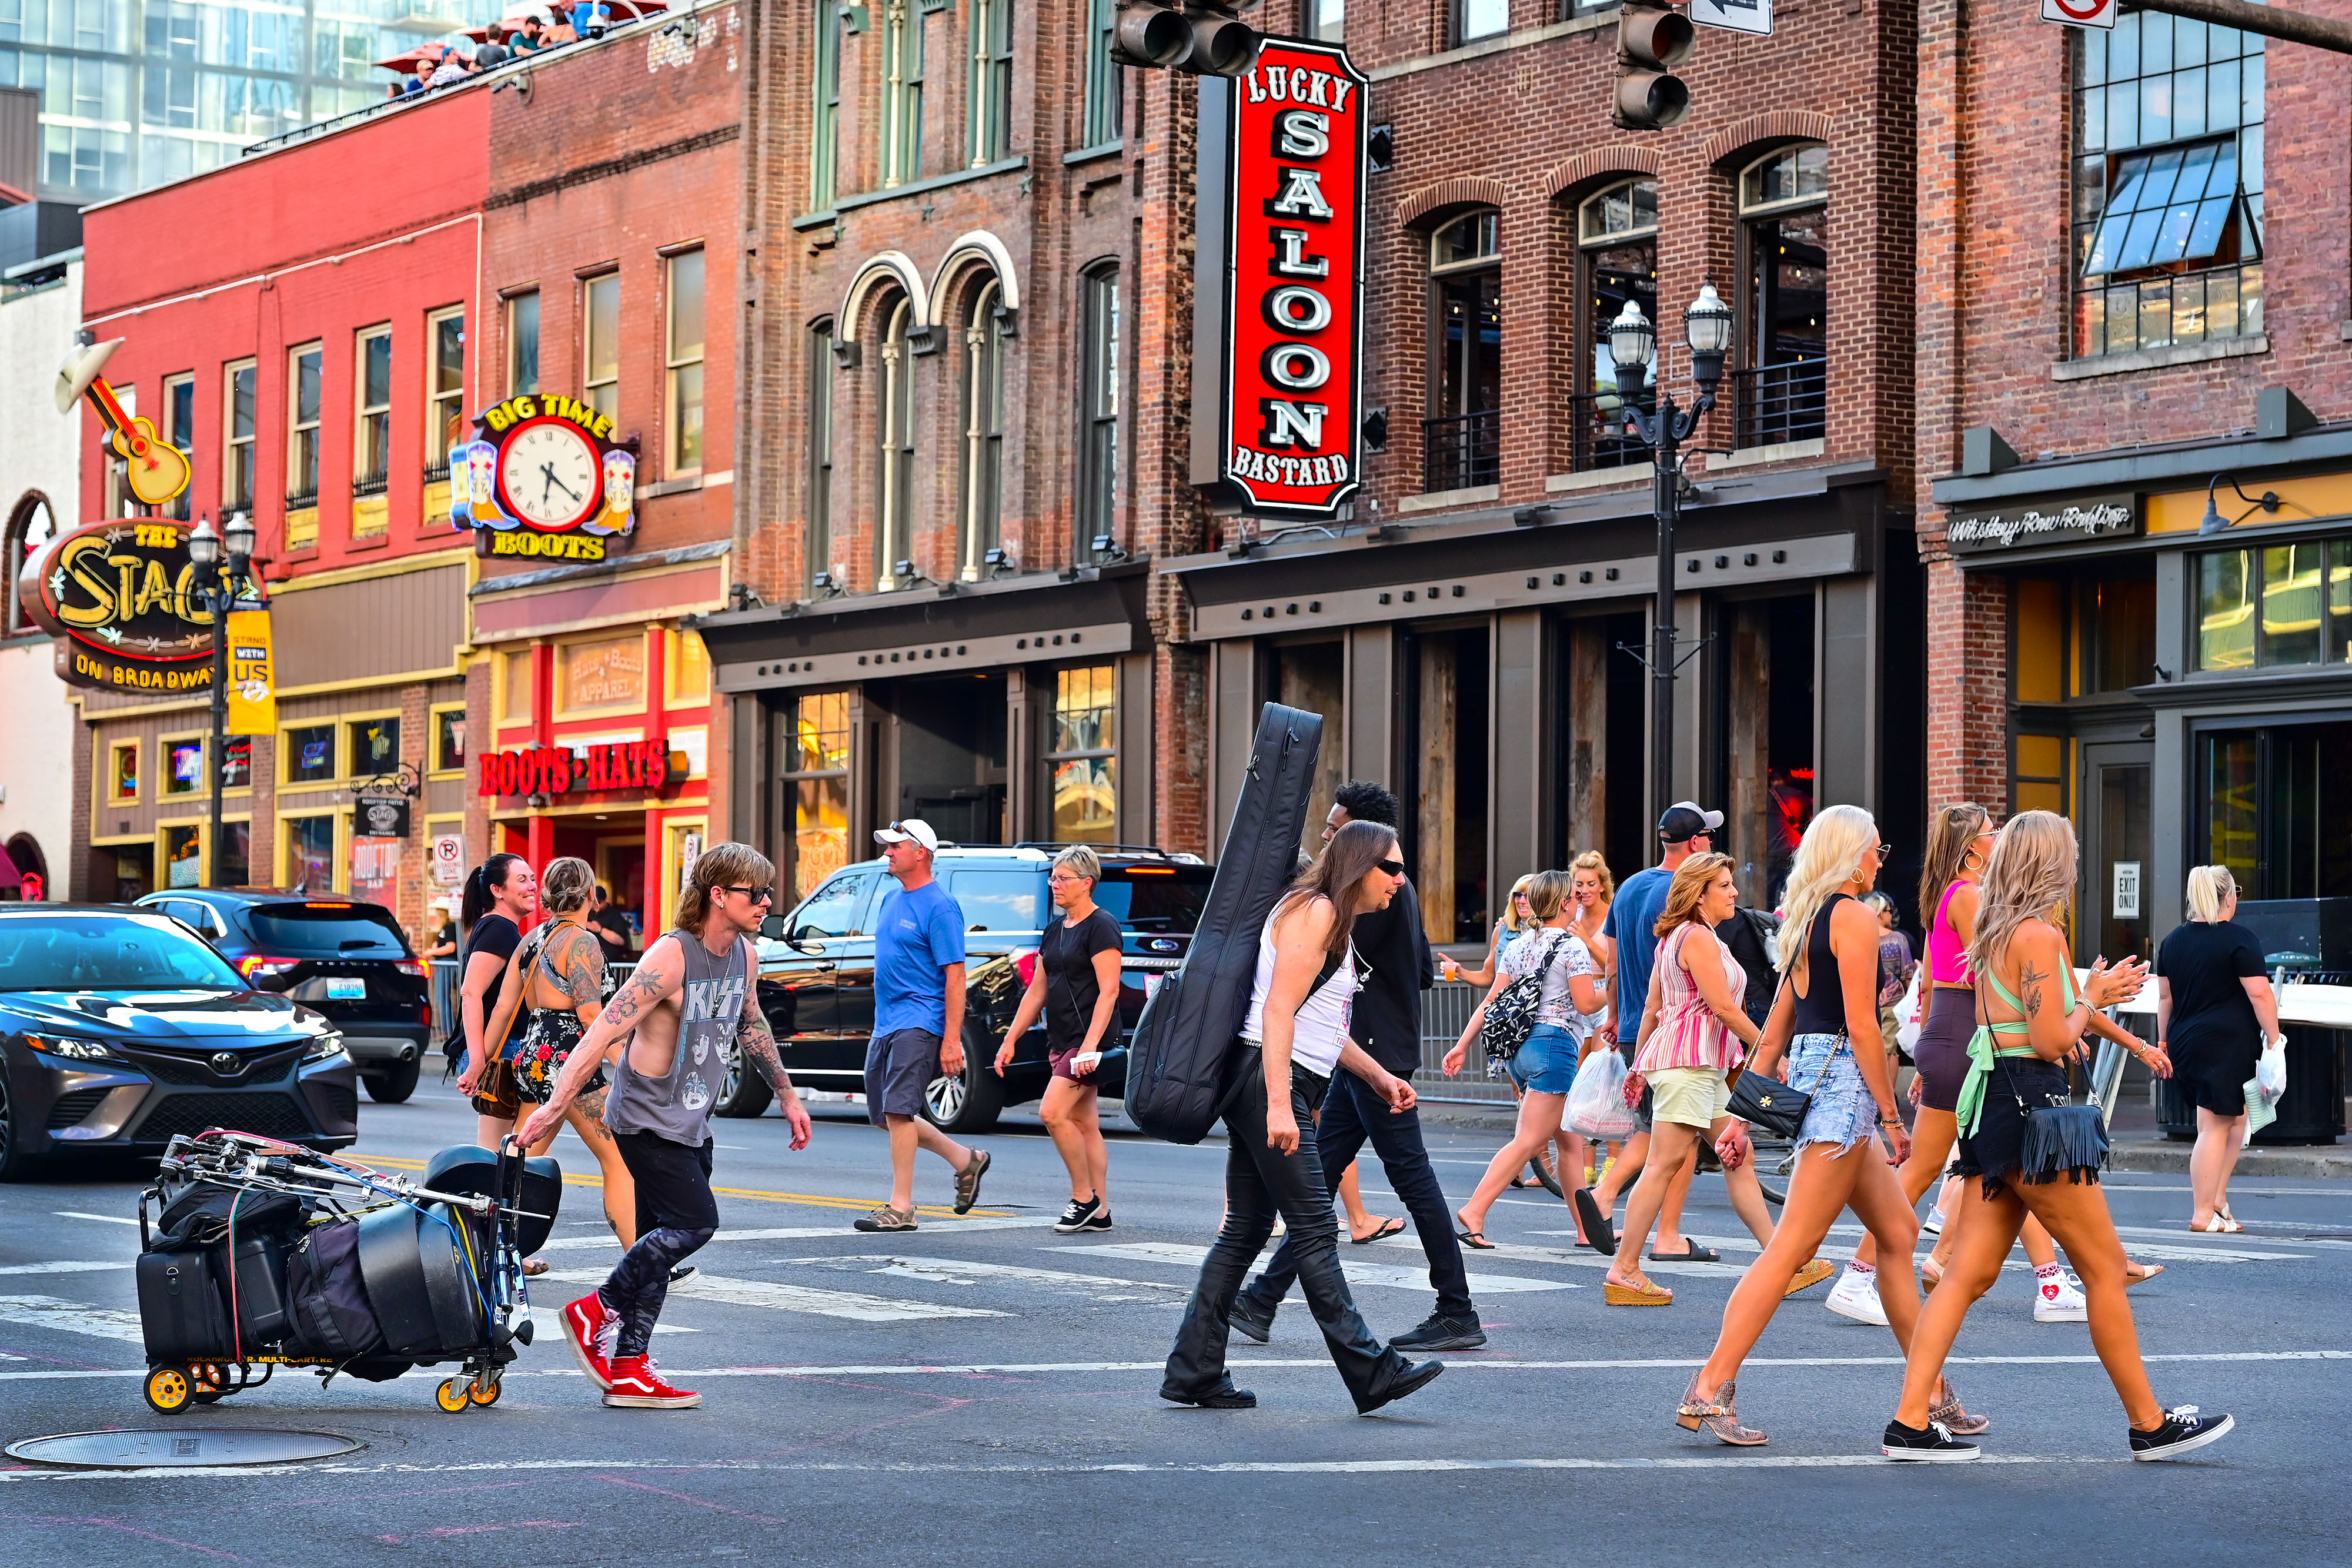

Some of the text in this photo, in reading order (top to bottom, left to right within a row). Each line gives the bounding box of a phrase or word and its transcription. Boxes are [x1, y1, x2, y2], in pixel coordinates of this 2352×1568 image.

[1247, 65, 1353, 113] LUCKY
[1264, 109, 1334, 450] SALOON
[485, 393, 613, 439] BIG TIME
[1232, 446, 1348, 487] BASTARD
[134, 523, 178, 549] THE
[492, 530, 605, 560] BOOTS
[234, 636, 266, 644] STAND
[236, 648, 265, 658] WITH
[76, 654, 216, 689] ON BROADWA
[235, 664, 268, 683] US
[579, 678, 632, 702] APPAREL
[478, 747, 570, 796] BOOTS
[587, 738, 667, 790] HATS
[2119, 878, 2136, 892] EXIT
[2119, 895, 2136, 909] ONLY
